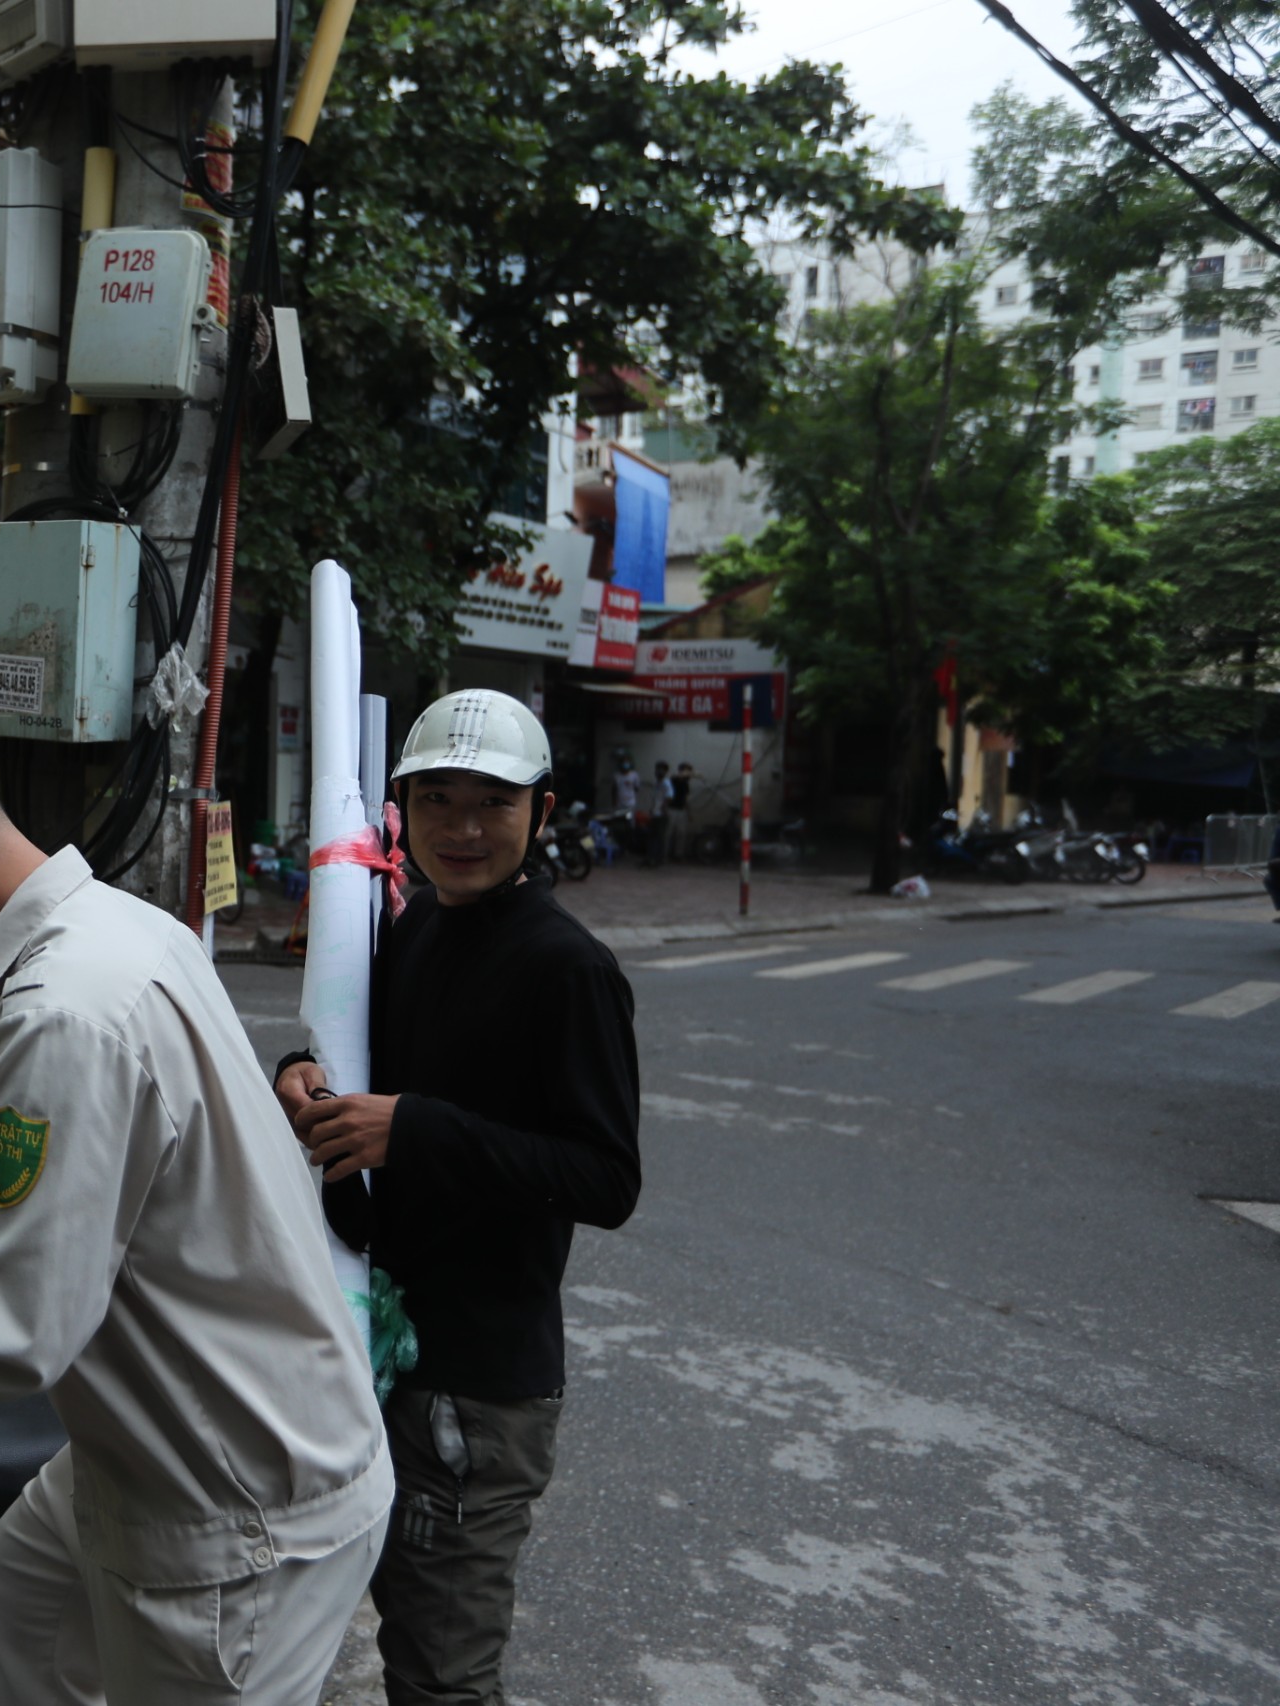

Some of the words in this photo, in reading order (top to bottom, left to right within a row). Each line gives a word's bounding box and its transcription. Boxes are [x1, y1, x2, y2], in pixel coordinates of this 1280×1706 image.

[104, 248, 155, 273] P128
[100, 281, 155, 304] 104/H
[671, 646, 735, 660] IDEMITSU
[19, 715, 63, 729] HO-04-2B
[25, 1130, 42, 1148] TỰ
[6, 1145, 23, 1163] THỊ
